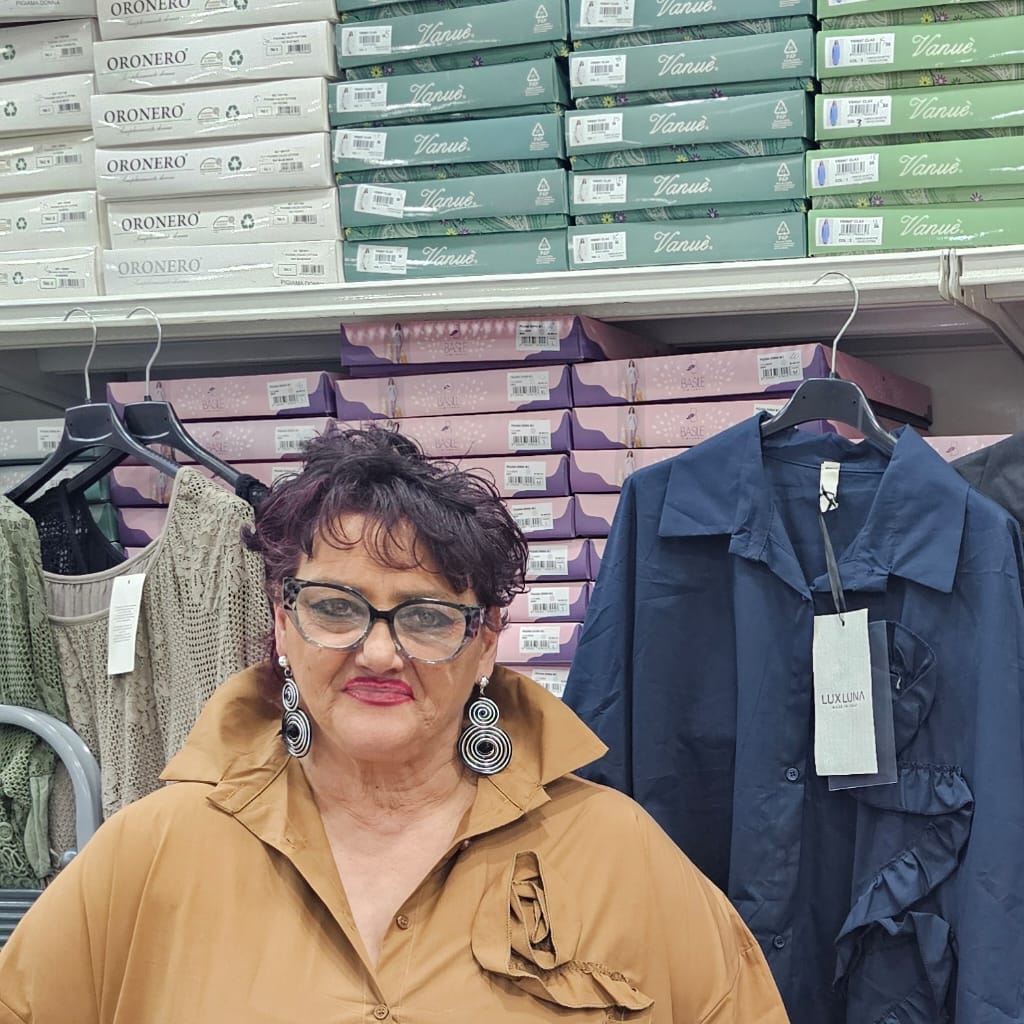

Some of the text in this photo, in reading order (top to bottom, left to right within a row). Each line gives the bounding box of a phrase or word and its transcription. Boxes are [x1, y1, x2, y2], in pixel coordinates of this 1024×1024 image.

[110, 0, 191, 17] ORONERO
[418, 21, 473, 44] Vanuè
[911, 34, 975, 58] Vanuè
[107, 50, 187, 71] ORONERO
[658, 53, 716, 77] Vanuè
[410, 82, 464, 104] Vanuè
[104, 104, 184, 124] ORONERO
[909, 97, 972, 120] Vanuè
[649, 112, 707, 135] Vanuè
[414, 133, 469, 155] Vanuè
[106, 155, 187, 173] ORONERO
[899, 154, 962, 177] Vanuè
[653, 174, 711, 197] Vanuè
[420, 188, 474, 209] Vanuè
[121, 213, 200, 232] ORONERO
[899, 215, 963, 236] Vanuè
[653, 231, 711, 254] Vanuè
[422, 246, 476, 266] Vanuè
[117, 258, 201, 276] ORONERO
[680, 377, 705, 389] BASILE
[679, 425, 705, 438] BASILE
